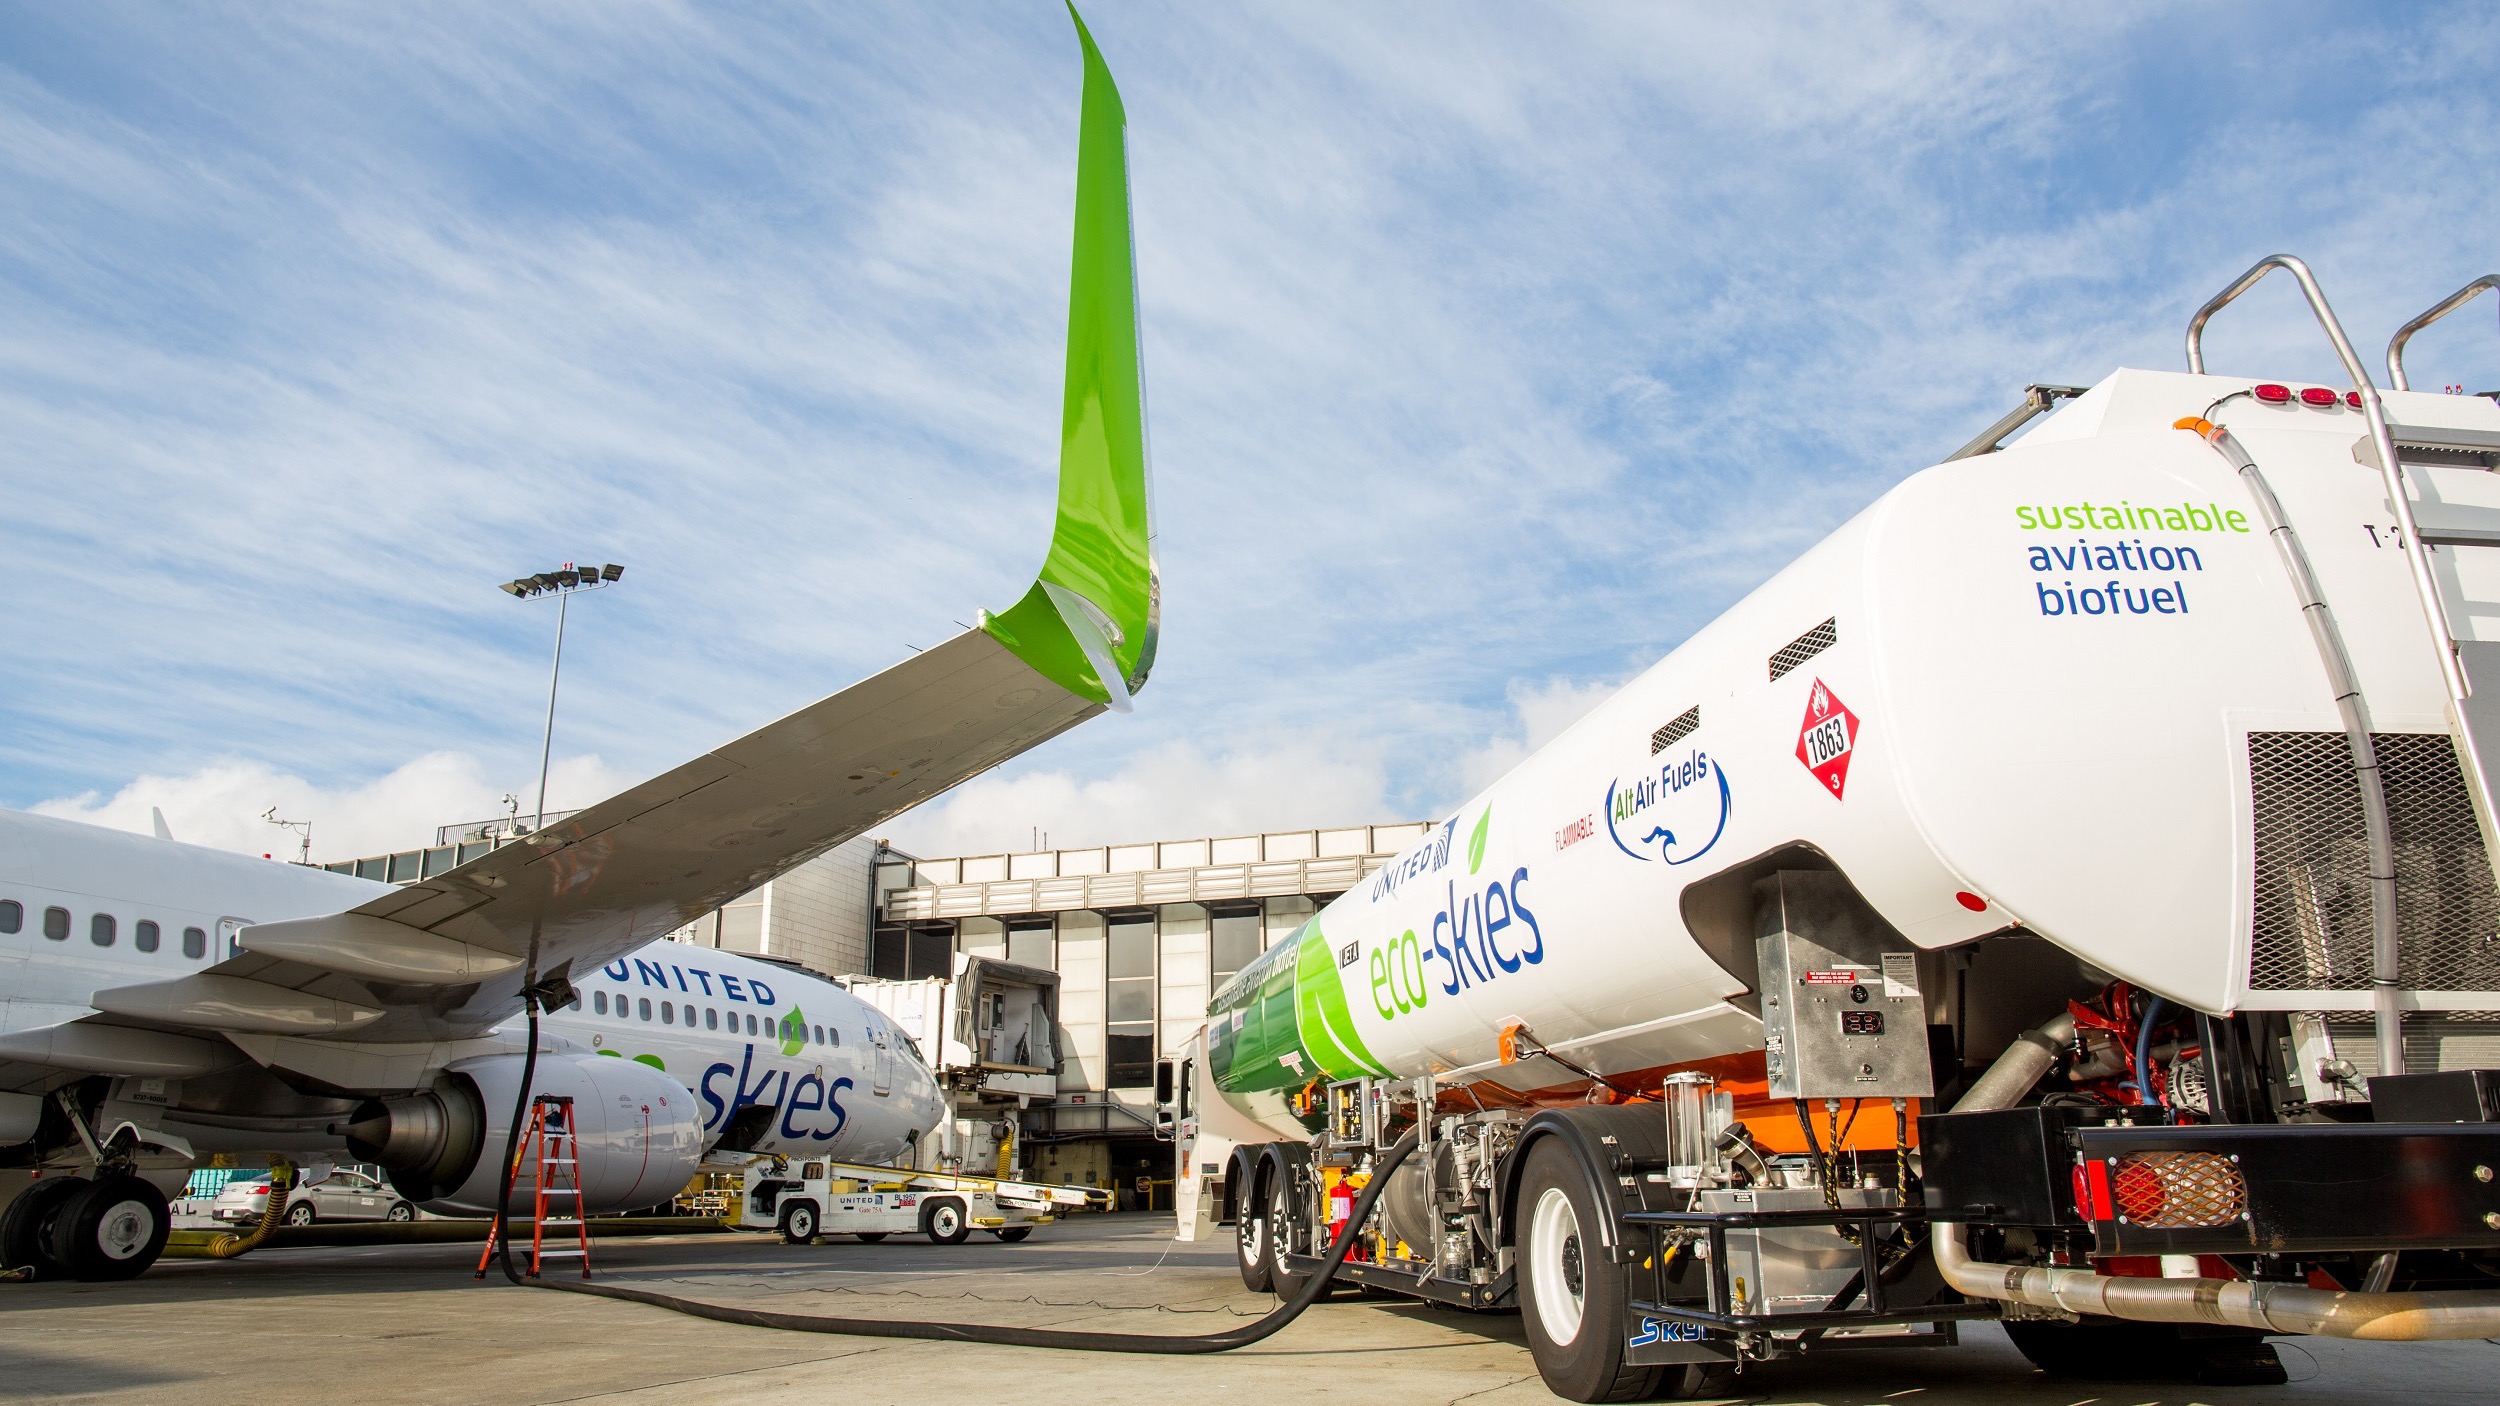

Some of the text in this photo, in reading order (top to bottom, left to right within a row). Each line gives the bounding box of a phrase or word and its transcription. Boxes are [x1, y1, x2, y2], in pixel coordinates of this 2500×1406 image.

[2015, 500, 2251, 533] sustainable
[2027, 539, 2203, 573] aviation
[2036, 580, 2189, 616] biofuel
[1808, 718, 1845, 764] 1863
[1615, 749, 1708, 825] AltAir Fuels
[1831, 773, 1841, 790] 3
[1555, 813, 1594, 852] FLAMMABLE
[1372, 843, 1433, 903] UNITED
[1370, 865, 1544, 1021] eco-skies
[604, 957, 776, 1006] UNITED
[1014, 1200, 1033, 1208] POINTS
